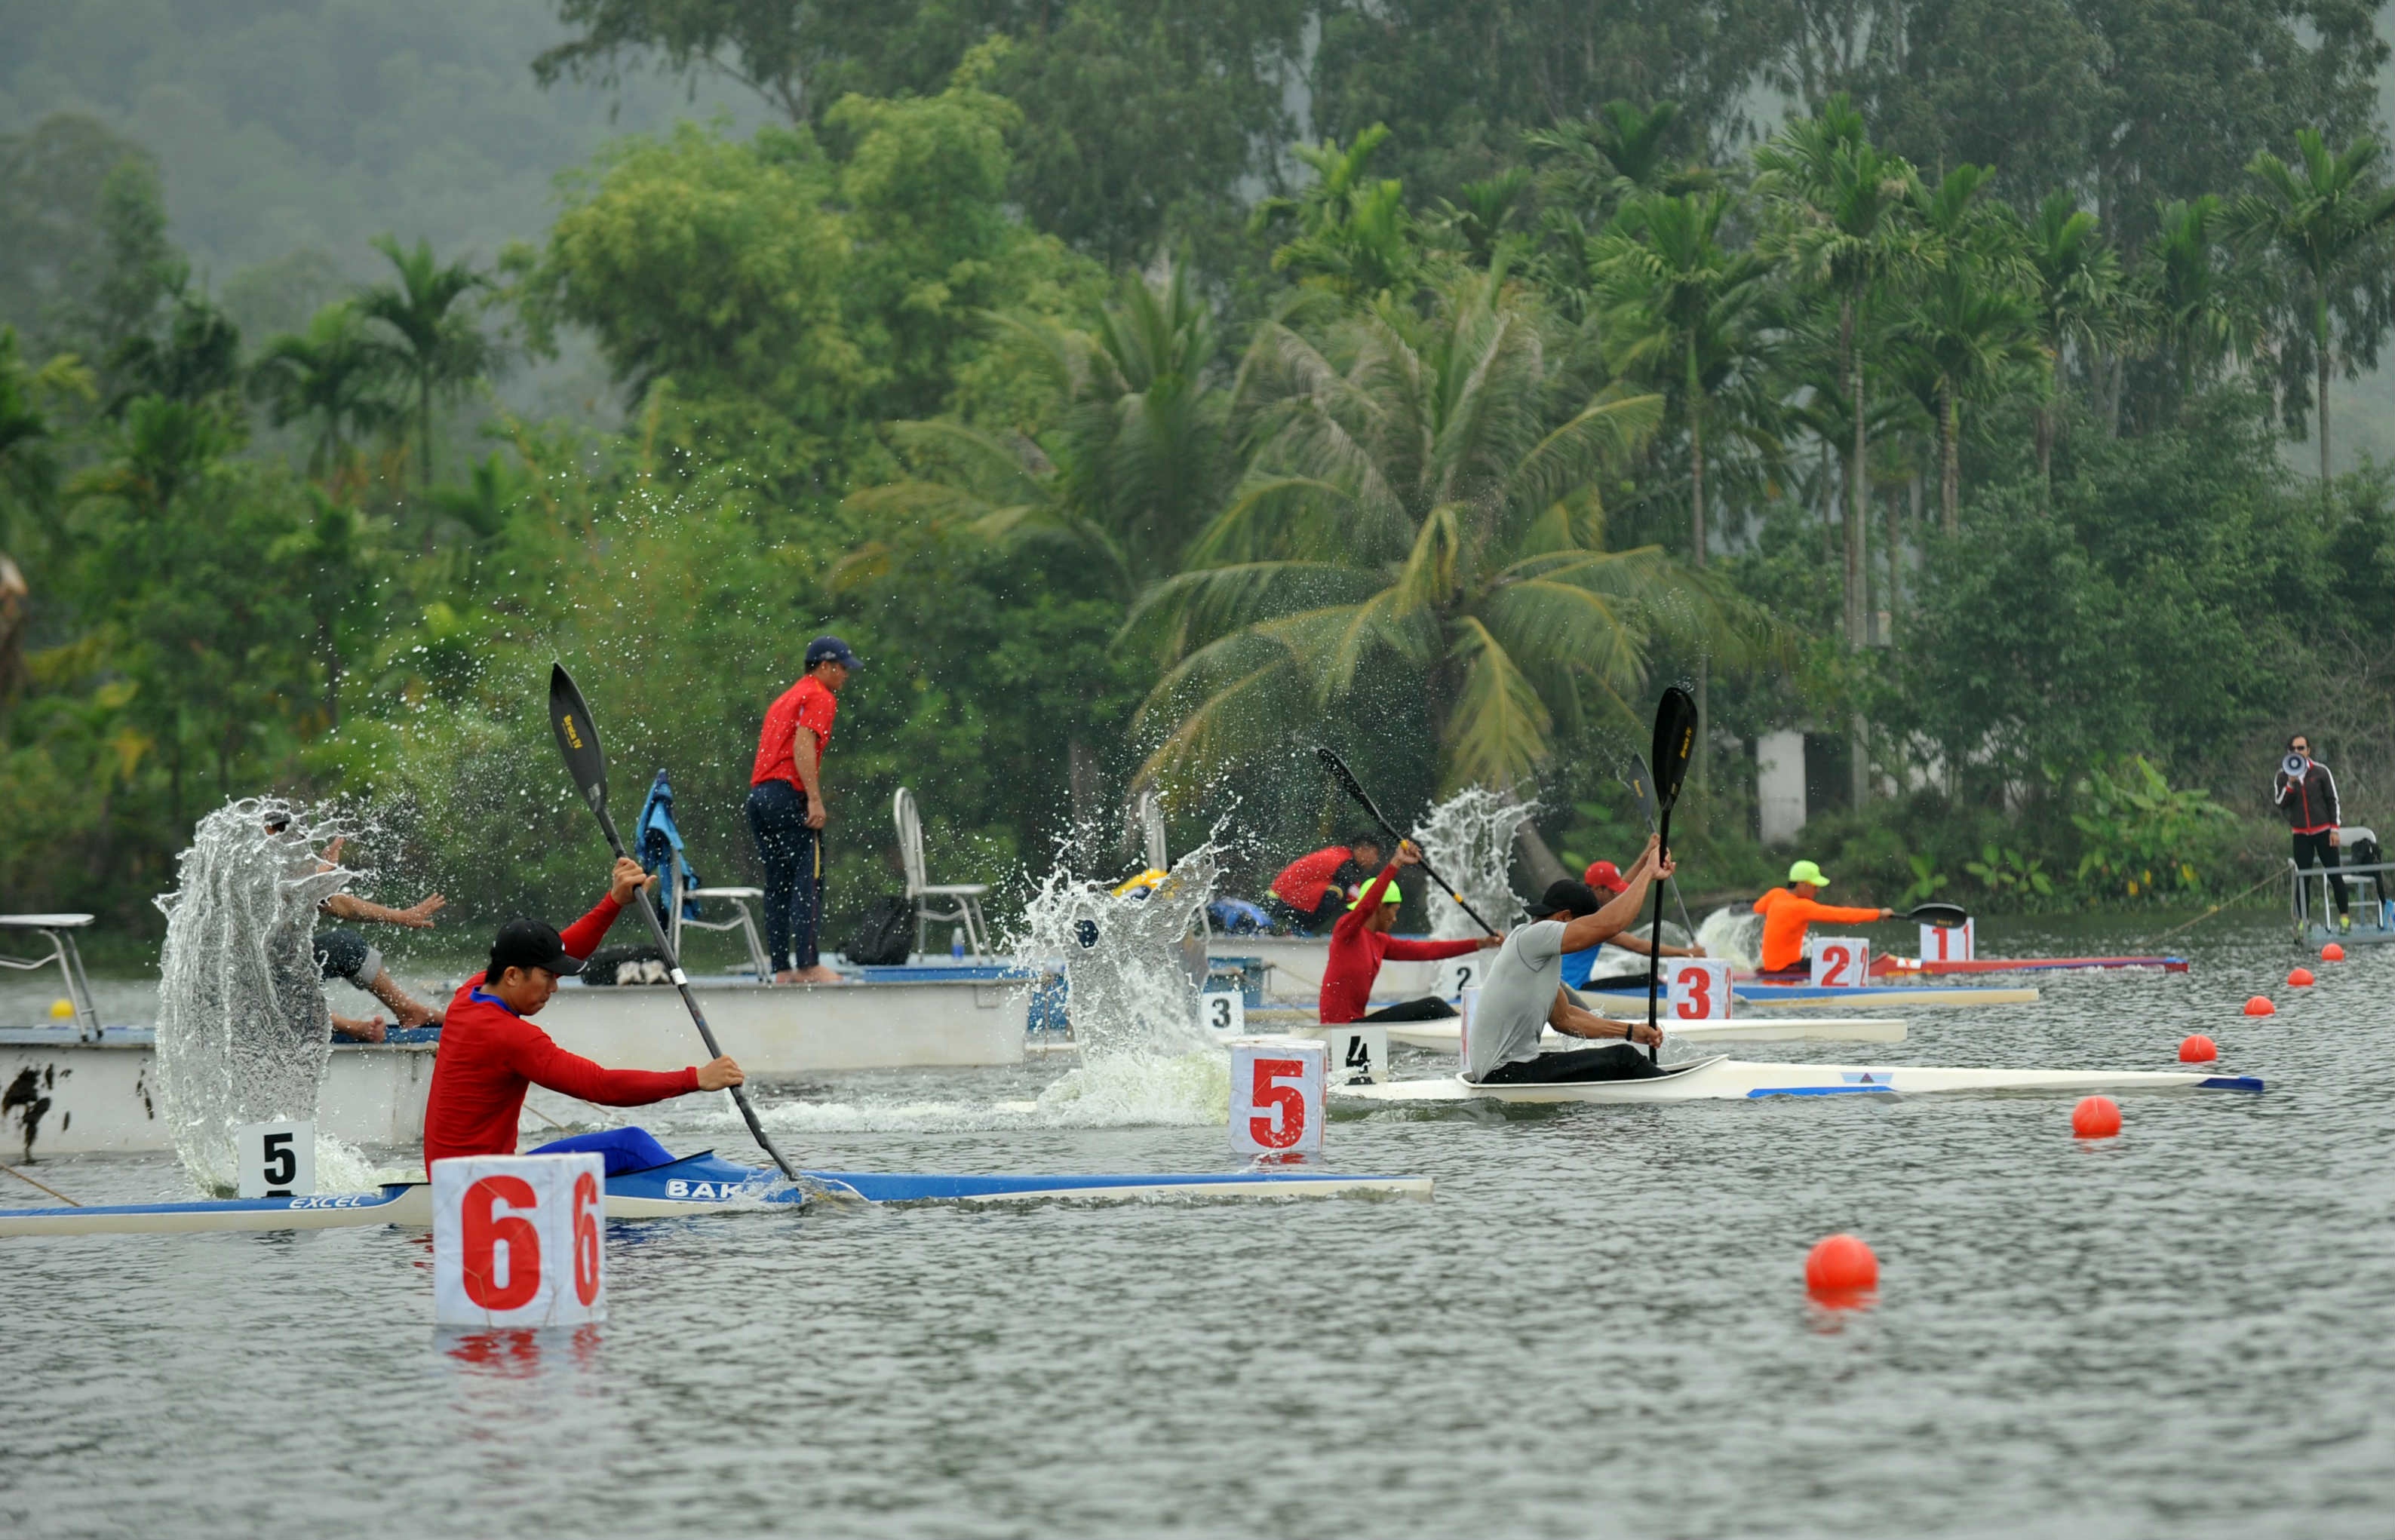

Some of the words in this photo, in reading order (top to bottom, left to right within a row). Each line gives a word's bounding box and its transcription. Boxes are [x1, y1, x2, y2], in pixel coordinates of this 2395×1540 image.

[1932, 927, 1948, 960] 1
[1963, 924, 1969, 960] 1
[1456, 967, 1472, 992] 2
[1821, 946, 1850, 986] 2
[1859, 946, 1868, 986] 2
[1211, 998, 1231, 1028] 3
[1677, 967, 1710, 1019] 3
[1346, 1035, 1371, 1073] 4
[1250, 1059, 1304, 1149] 5
[264, 1133, 296, 1185] 5
[290, 1196, 361, 1209] EXCEL
[462, 1175, 540, 1311] 6
[573, 1172, 599, 1306] 6
